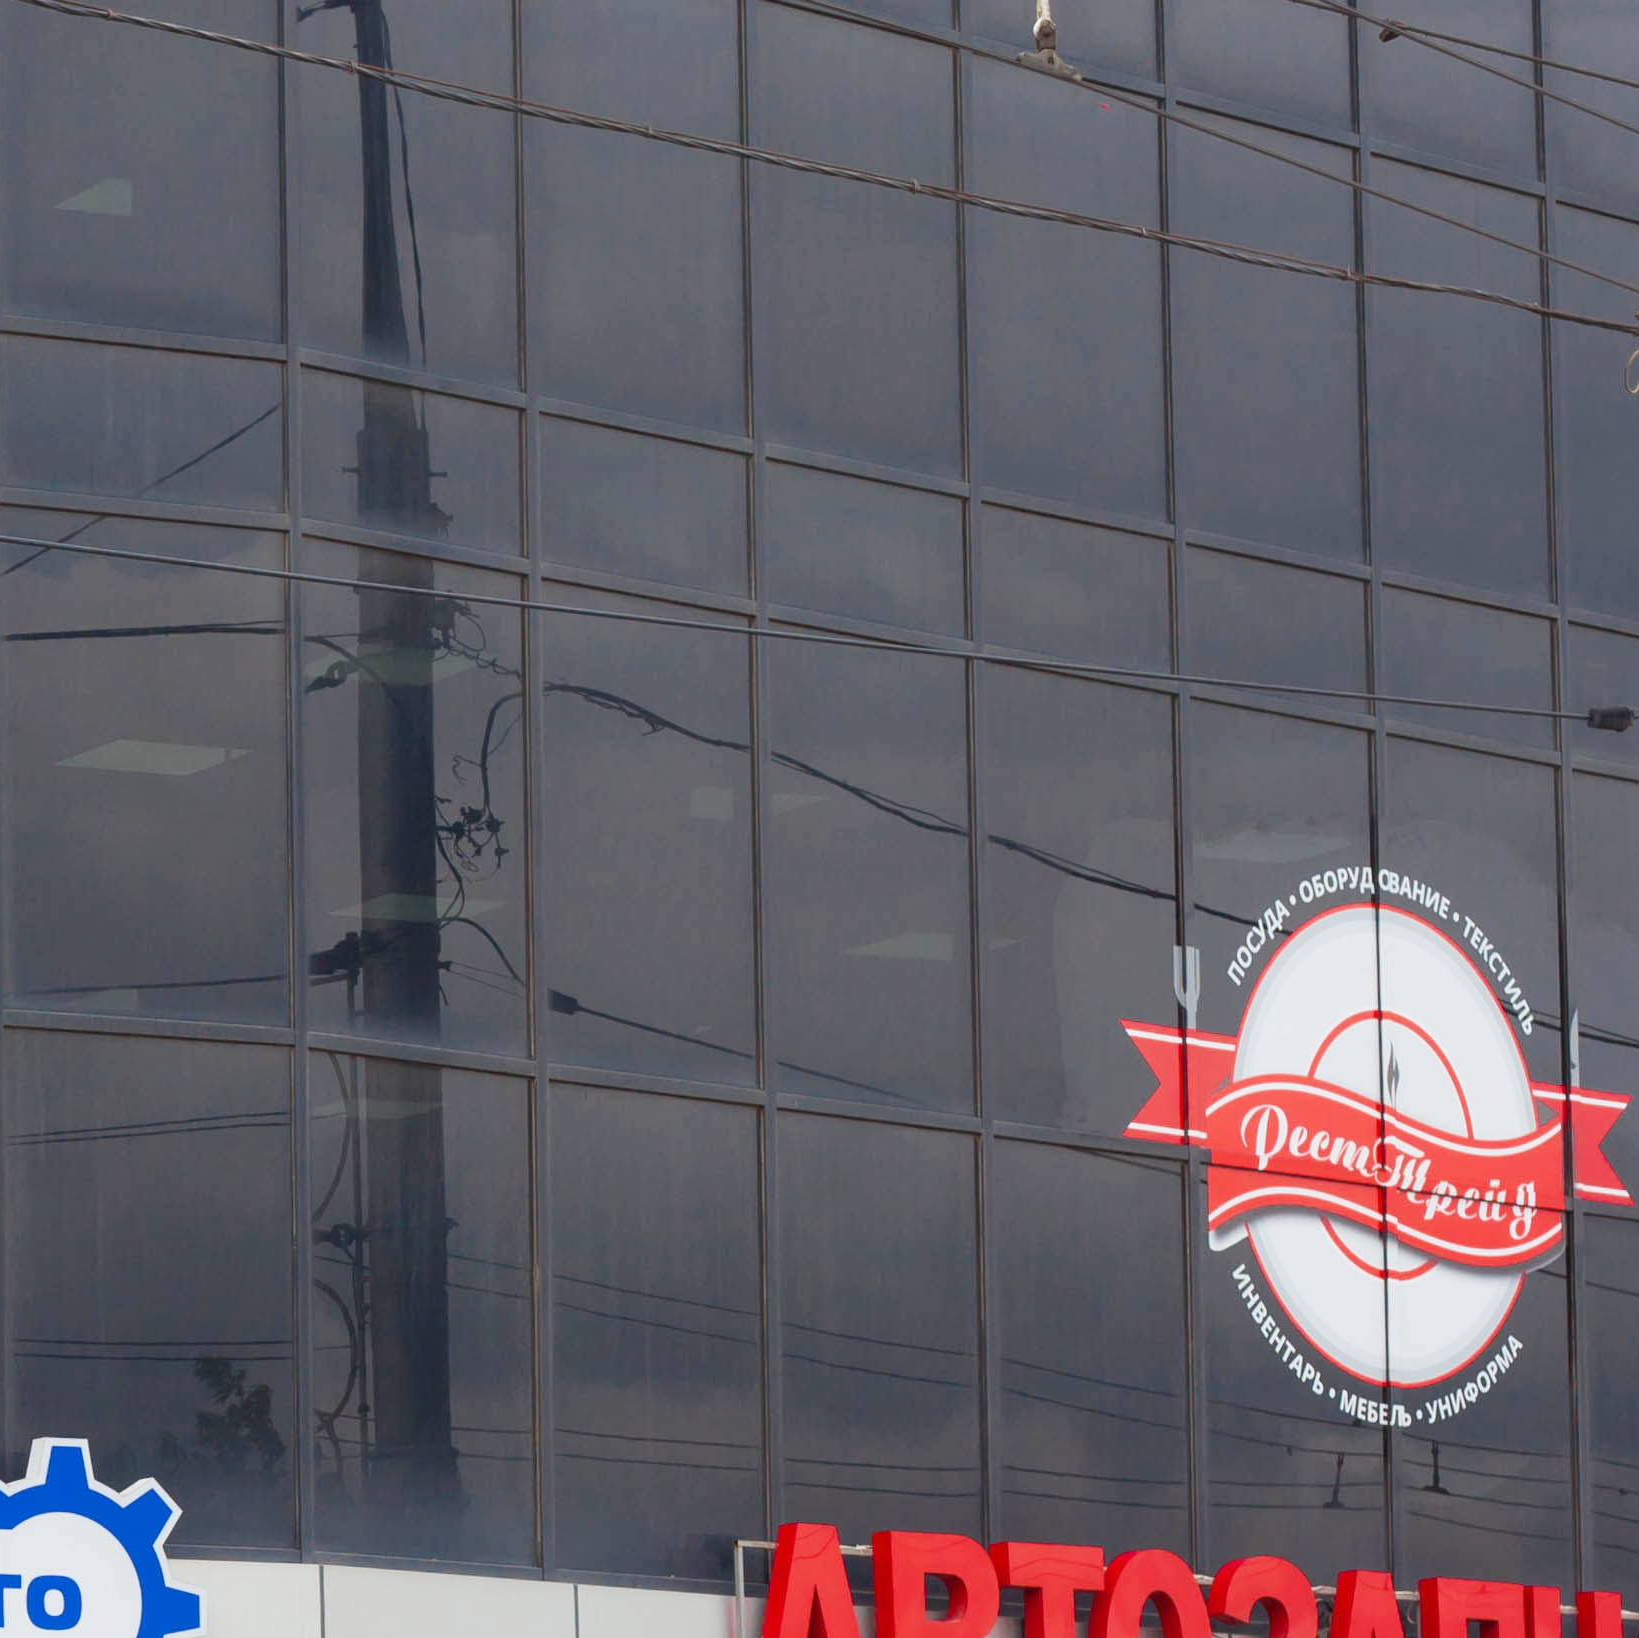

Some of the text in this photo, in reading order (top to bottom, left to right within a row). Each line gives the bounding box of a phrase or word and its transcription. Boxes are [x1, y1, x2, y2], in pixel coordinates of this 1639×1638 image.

[1226, 866, 1534, 1036] ПОСУДА ОБОРУДОВАНИЕ ТЕКСТИЛЬ
[1231, 1264, 1523, 1428] ИНВЕНТАРЬ МЕБЕЛЬ УНИФОРМА
